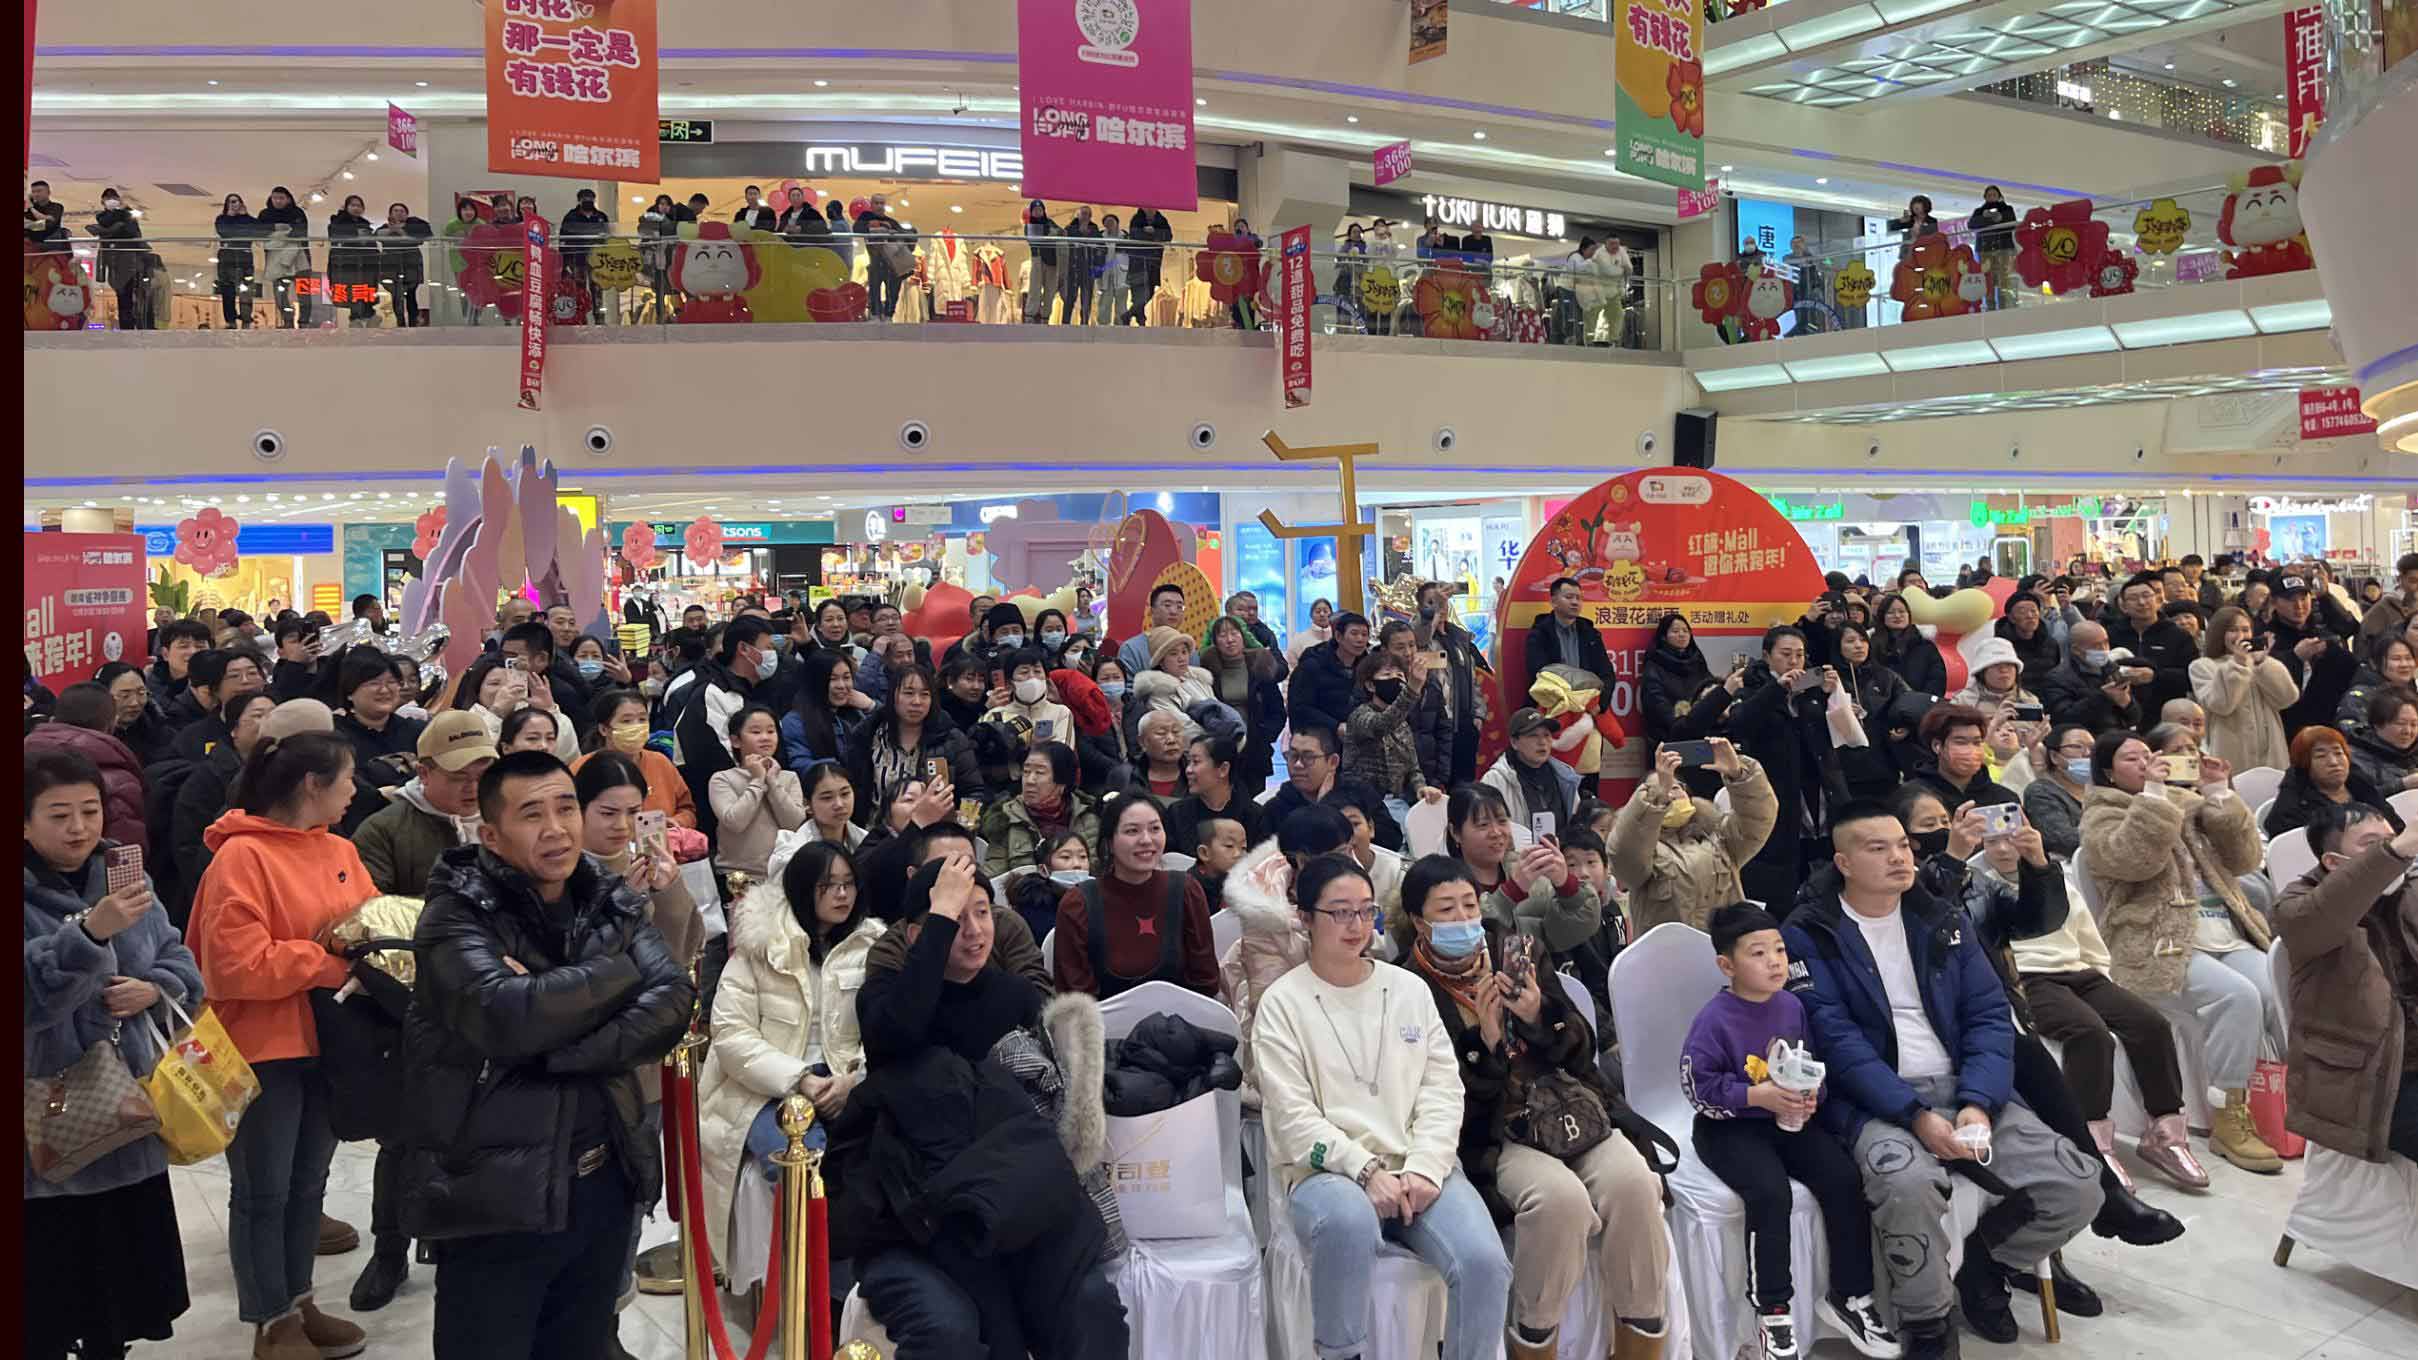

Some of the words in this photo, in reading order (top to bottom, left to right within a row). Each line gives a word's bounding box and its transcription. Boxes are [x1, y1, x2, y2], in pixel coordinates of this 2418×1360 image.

[504, 21, 639, 66] 那一定是
[1628, 4, 1692, 60] 有钱花
[505, 60, 611, 101] 有钱花
[1095, 115, 1187, 150] 哈尔滨
[563, 143, 640, 168] 哈尔滨
[1563, 1114, 1580, 1141] B
